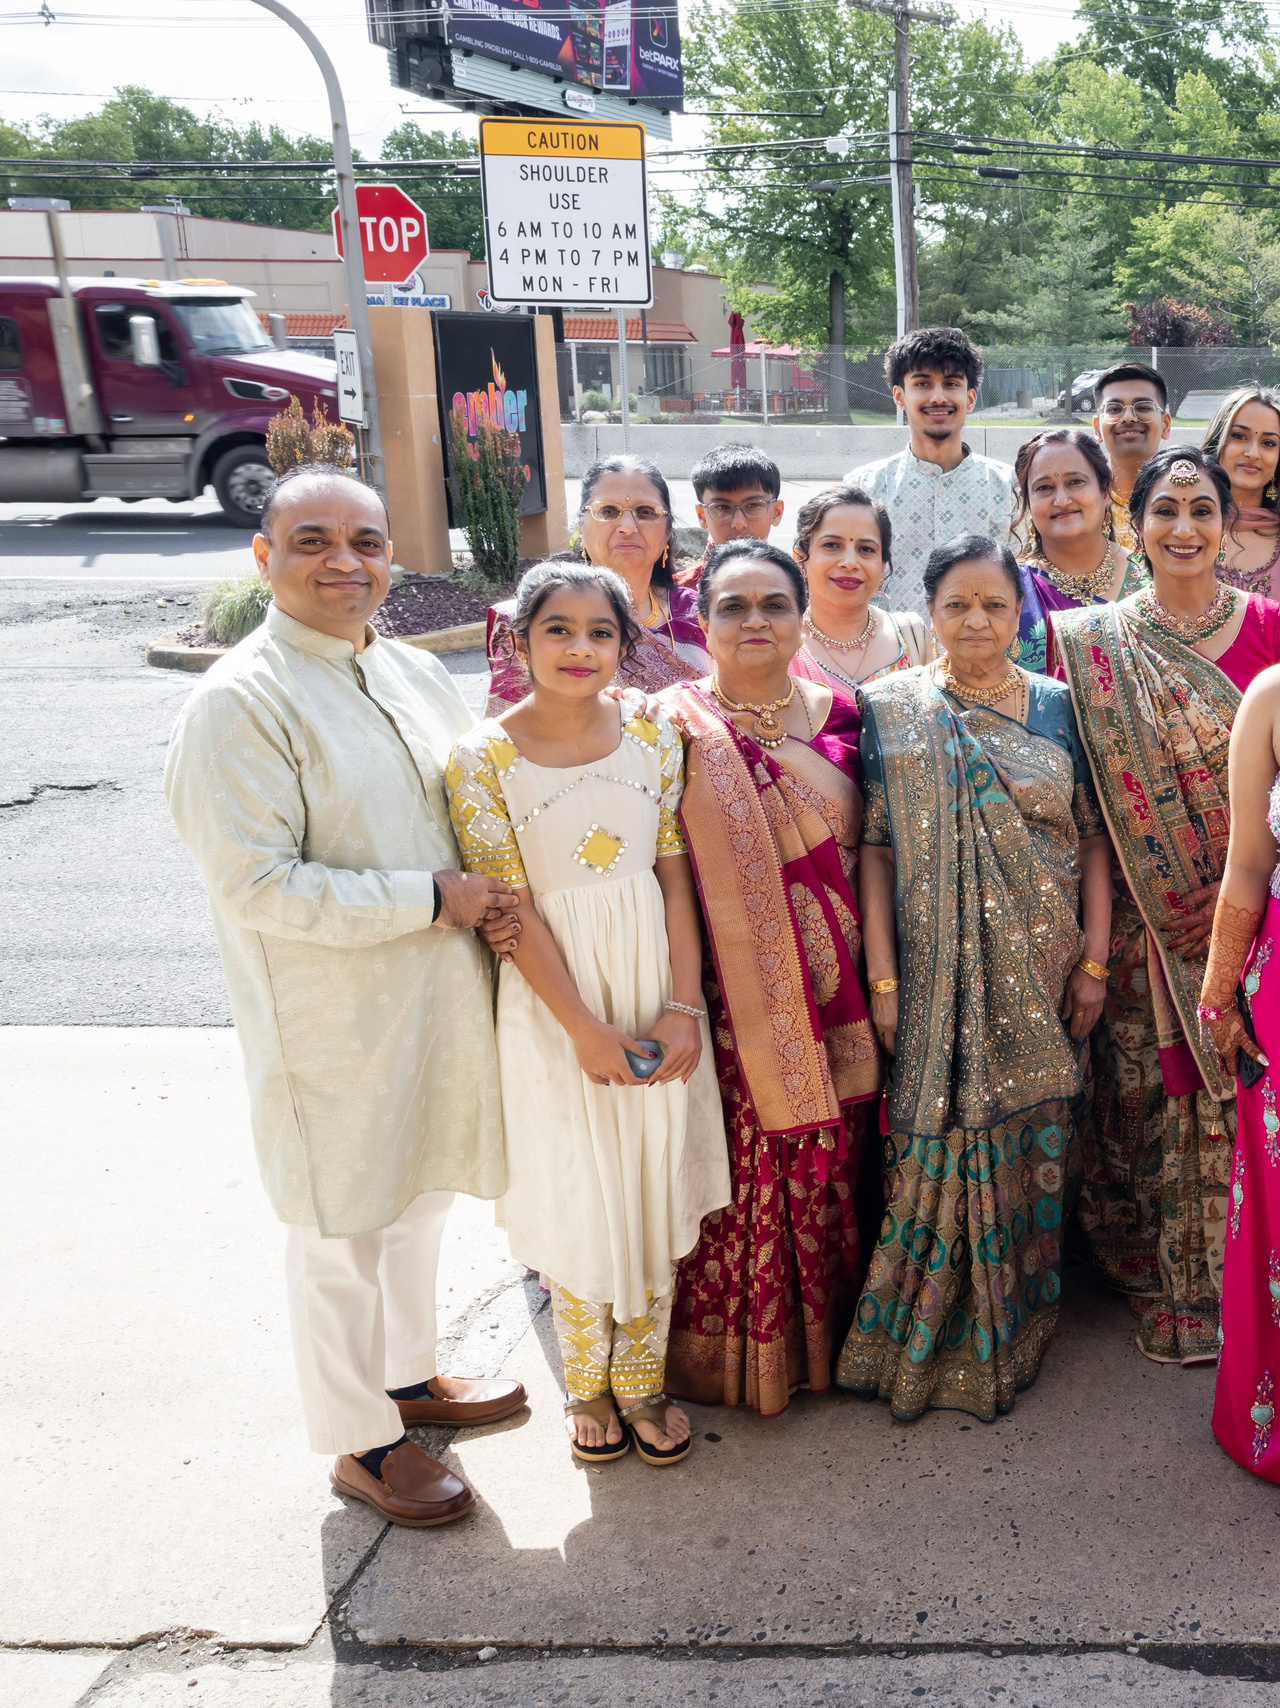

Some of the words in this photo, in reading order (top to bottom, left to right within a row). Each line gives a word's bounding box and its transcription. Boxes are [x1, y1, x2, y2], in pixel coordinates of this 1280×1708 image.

[528, 15, 563, 42] REWARDS.
[454, 32, 484, 49] GAMBLING
[484, 42, 513, 57] PROBLEM?
[512, 50, 526, 61] CALL
[639, 45, 680, 72] betPARX
[527, 131, 599, 151] CAUTION
[519, 164, 609, 184] SHOULDER
[549, 193, 581, 210] USE
[359, 216, 421, 253] TOP
[497, 221, 507, 238] 6
[517, 221, 542, 238] AM
[551, 222, 573, 239] TO
[583, 222, 602, 239] 10
[612, 223, 637, 240] AM
[499, 248, 509, 265] 4
[521, 249, 547, 265] PM
[558, 249, 581, 266] TO
[592, 250, 601, 266] 7
[613, 250, 639, 267] PM
[522, 275, 563, 293] MON
[589, 277, 620, 293] FRI
[366, 296, 409, 307] MAKET
[411, 297, 447, 308] PLACE
[340, 350, 356, 376] EXIT
